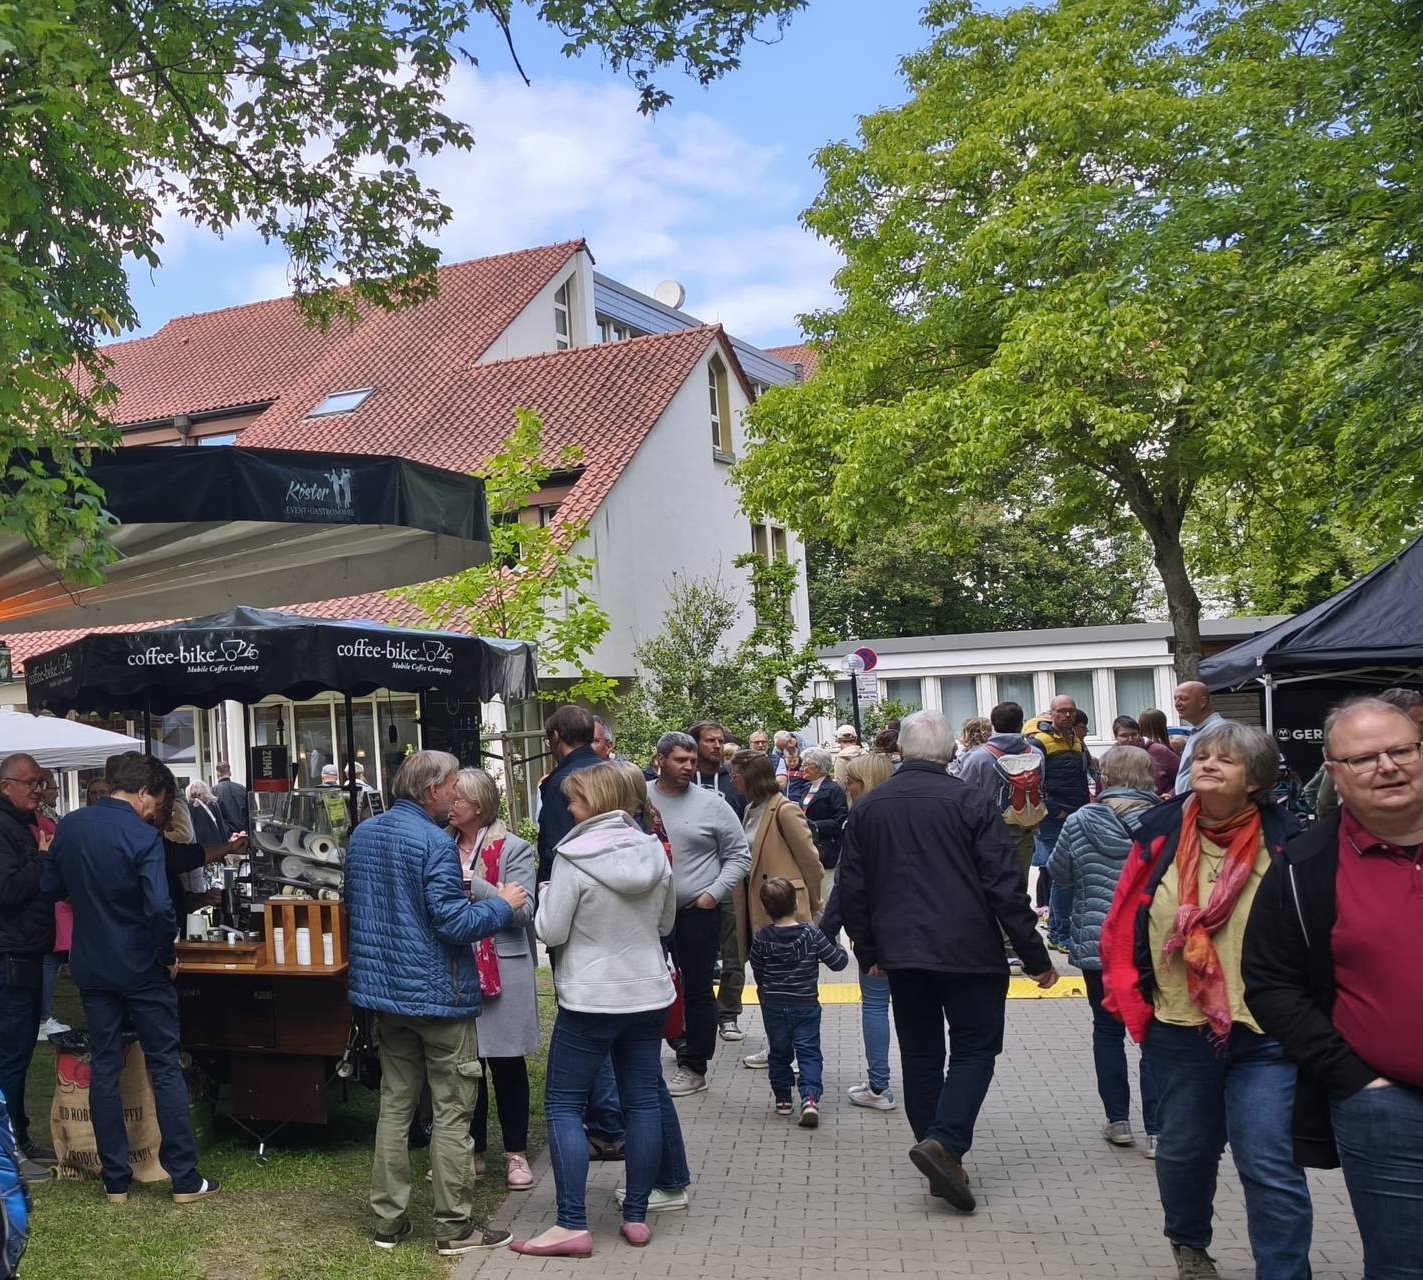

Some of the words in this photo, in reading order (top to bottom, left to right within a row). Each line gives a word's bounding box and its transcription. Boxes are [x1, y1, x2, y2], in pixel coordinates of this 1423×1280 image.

[285, 480, 329, 503] Köster
[127, 645, 215, 666] coffee-bike
[337, 638, 418, 660] coffee-bike
[187, 665, 208, 673] Mobile
[209, 665, 229, 673] Coffee
[229, 664, 259, 672] Company
[391, 662, 410, 670] Mobile
[411, 663, 427, 672] Coffee
[427, 665, 452, 675] Company
[1292, 728, 1323, 740] GER
[261, 750, 273, 776] ZUMA
